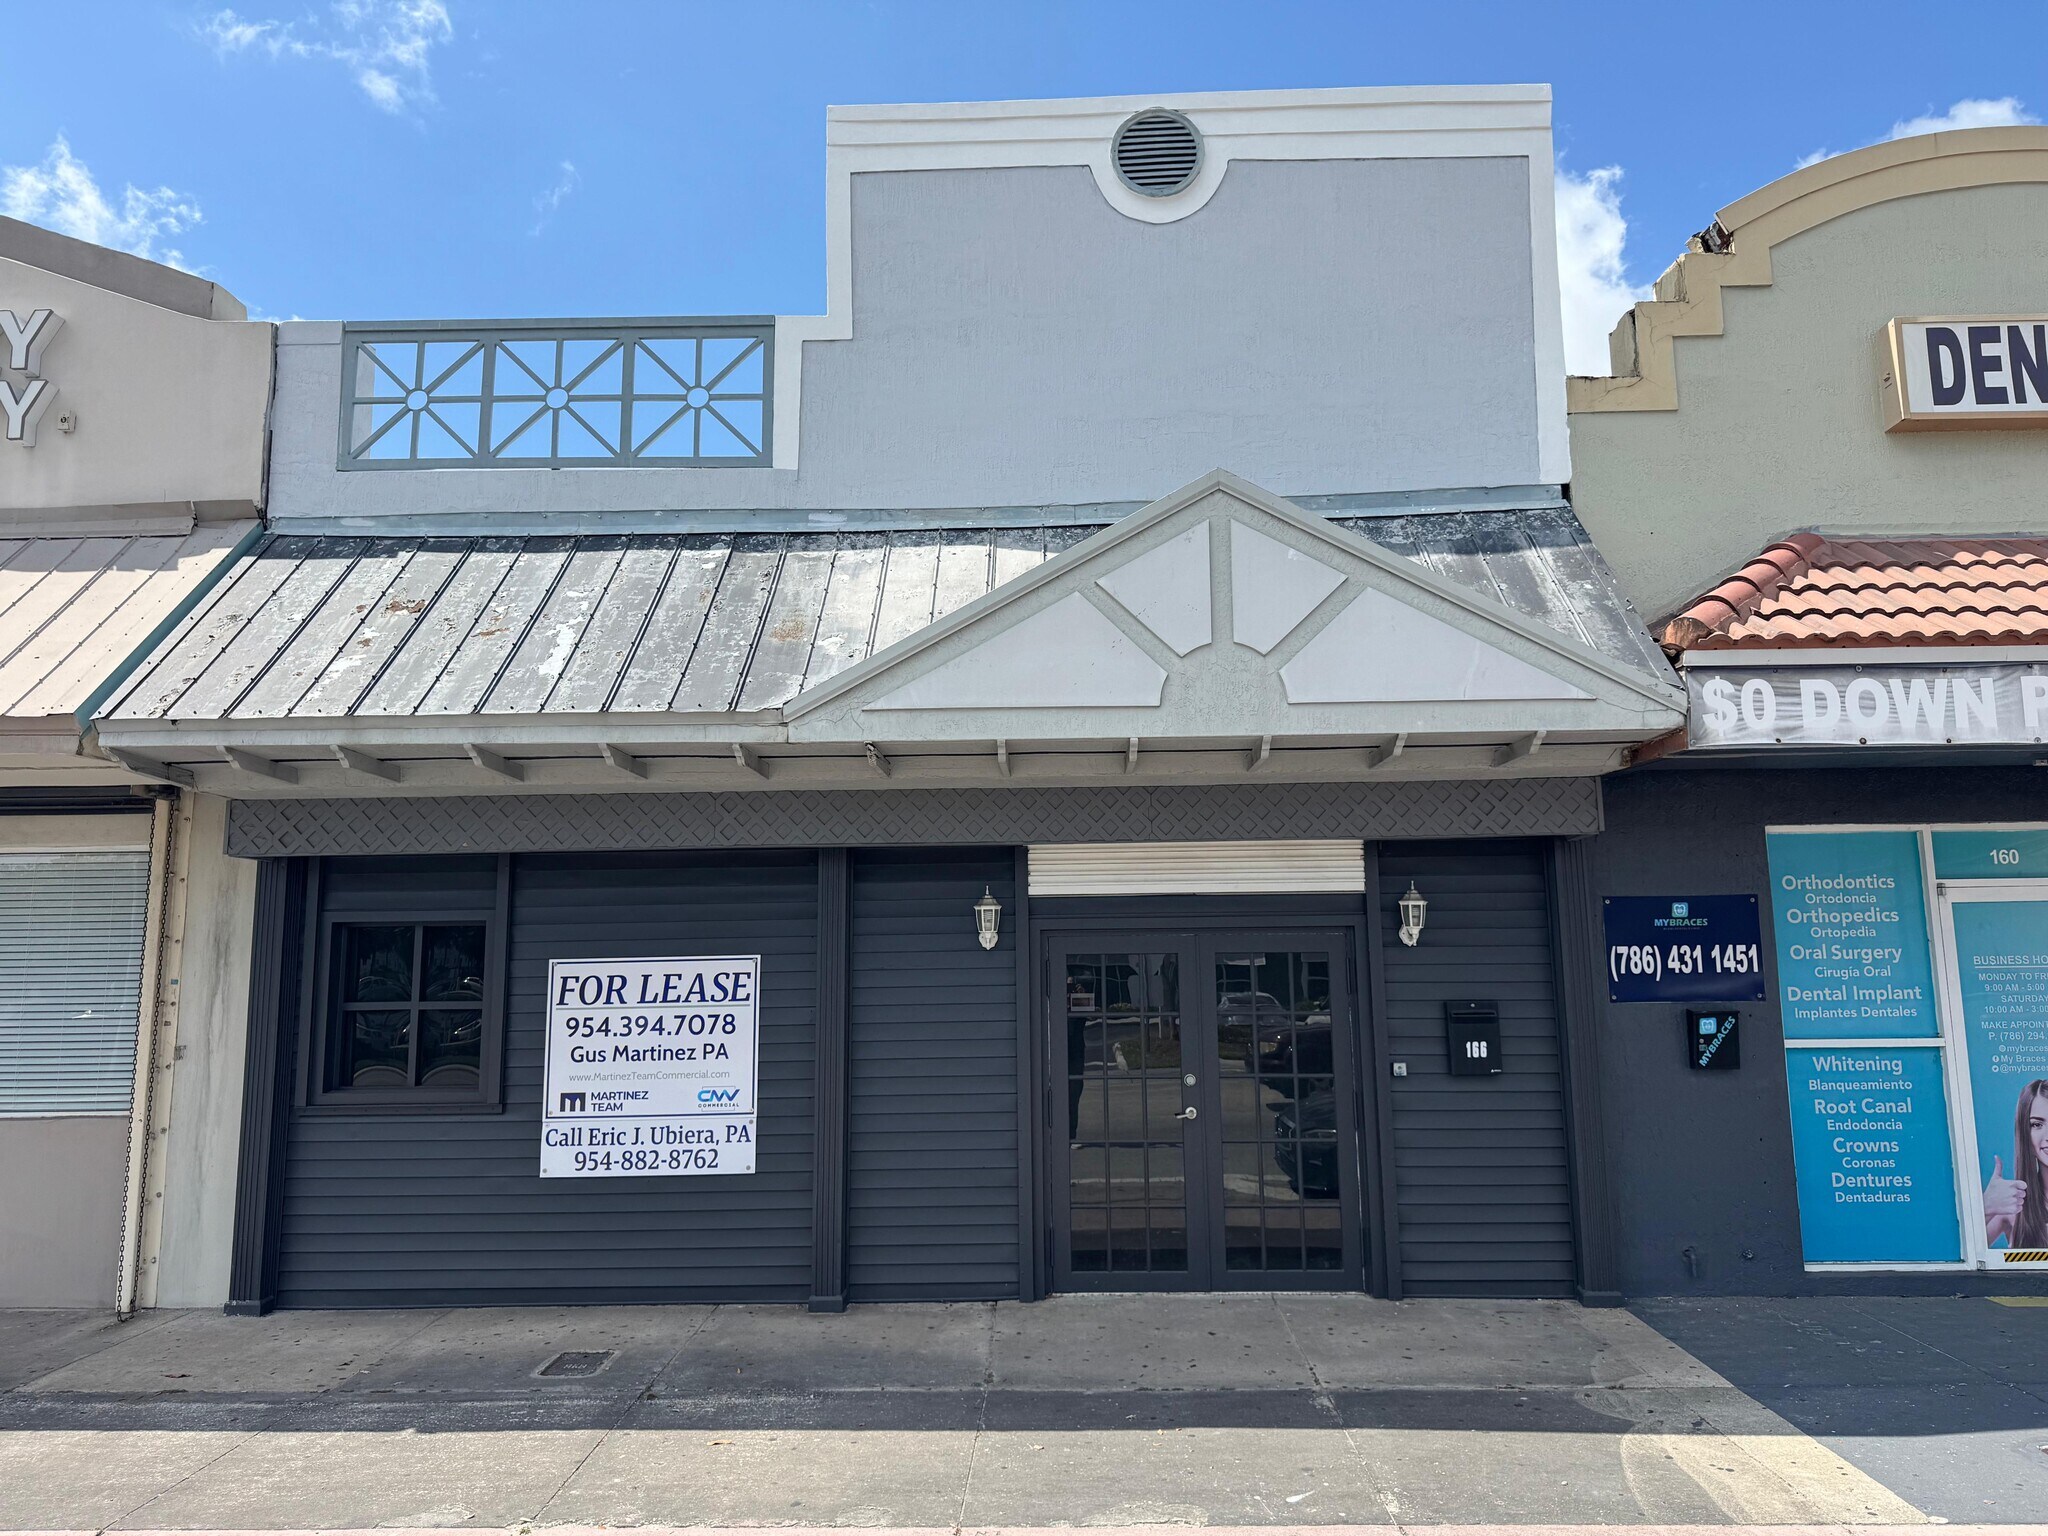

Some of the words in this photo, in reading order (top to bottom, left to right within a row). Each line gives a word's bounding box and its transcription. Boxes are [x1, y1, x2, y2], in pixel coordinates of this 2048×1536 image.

[1925, 324, 2048, 406] DEN
[1701, 675, 1777, 736] $0
[1800, 676, 1997, 730] DOWN
[1989, 848, 2020, 865] 160
[1781, 874, 1895, 891] Orthodontics
[1804, 893, 1877, 905] Ortodoncia
[1654, 918, 1709, 927] MYBRACES
[1786, 907, 1900, 927] Orthopedics
[1810, 926, 1877, 940] Ortopedia
[1790, 943, 1827, 960] Oral
[1831, 944, 1902, 964] Surgery
[1973, 955, 2030, 965] BUSINESS
[1610, 945, 1662, 982] (786)
[1667, 944, 1704, 974] 431
[1711, 943, 1759, 973] 1451
[1863, 965, 1892, 977] Oral
[1978, 973, 2018, 981] MONDAY
[2020, 972, 2033, 980] TO
[555, 974, 629, 1006] FOR
[636, 971, 753, 1005] LEASE
[1787, 985, 1847, 1001] Dental
[1853, 985, 1922, 1004] Implant
[1984, 983, 2003, 991] 9:00
[2005, 983, 2019, 991] AM
[2027, 983, 2045, 991] 5:00
[1795, 1006, 1857, 1021] Implantes
[1861, 1006, 1918, 1018] Dentales
[1985, 1005, 2008, 1013] 10:00
[2009, 1005, 2024, 1013] AM
[565, 1013, 737, 1038] 954.394.7078
[1981, 1021, 2008, 1029] MAKE
[1698, 1015, 1736, 1067] MYBRACES
[2000, 1031, 2025, 1042] (786)
[570, 1045, 607, 1063] Gus
[612, 1044, 697, 1063] Martinez
[702, 1042, 730, 1060] PA
[1465, 1041, 1488, 1058] 166
[1812, 1055, 1903, 1076] Whitening
[2015, 1054, 2046, 1062] Braces
[568, 1069, 731, 1083] www.MartinezTeamCommercial.com
[1809, 1079, 1913, 1094] Blanqueamiento
[590, 1090, 650, 1101] MARTINEZ
[590, 1102, 624, 1112] TEAM
[1814, 1099, 1857, 1115] Root
[1861, 1097, 1913, 1114] Canal
[1826, 1119, 1903, 1131] Endodoncia
[545, 1128, 583, 1148] Call
[587, 1127, 627, 1147] Eric
[630, 1127, 645, 1146] J.
[649, 1125, 720, 1146] Ubiera,
[724, 1124, 752, 1144] PA
[1832, 1137, 1900, 1153] Crowns
[574, 1148, 719, 1172] 954-882-8762
[1842, 1156, 1896, 1168] Coronas
[1831, 1172, 1912, 1188] Dentures
[1834, 1191, 1911, 1203] Dentaduras
